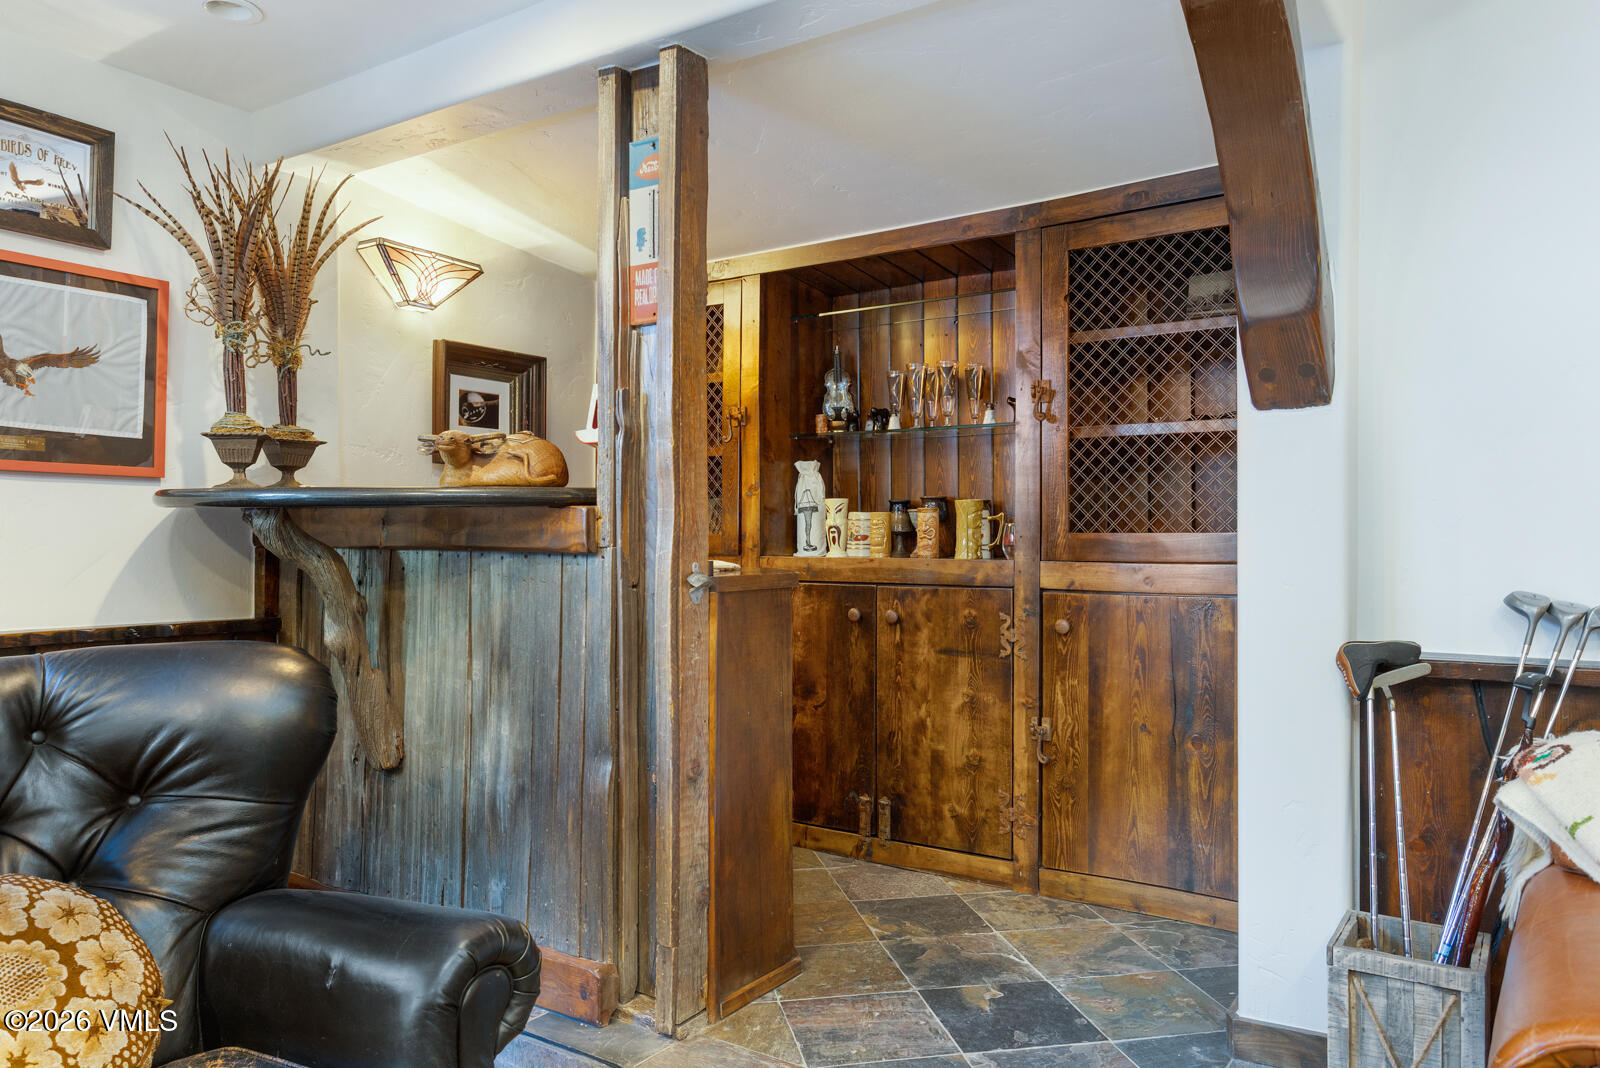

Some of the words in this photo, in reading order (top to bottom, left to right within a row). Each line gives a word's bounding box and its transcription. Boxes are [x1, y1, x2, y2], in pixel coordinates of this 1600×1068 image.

[1, 139, 32, 158] BIRDS
[37, 148, 49, 162] OF
[635, 268, 653, 287] MADE
